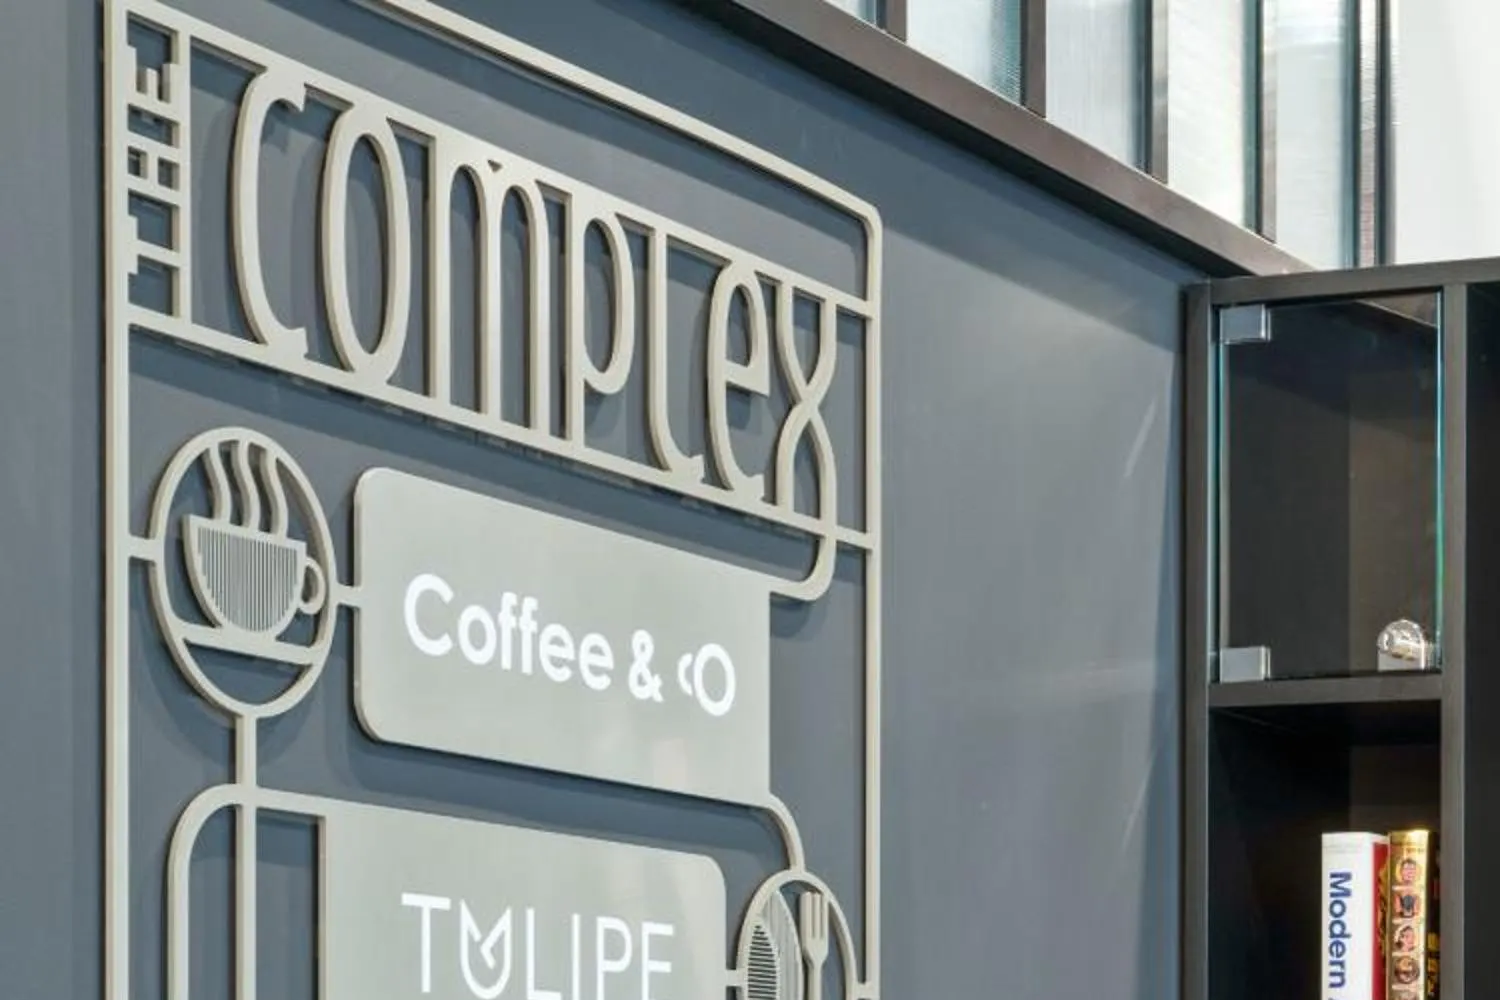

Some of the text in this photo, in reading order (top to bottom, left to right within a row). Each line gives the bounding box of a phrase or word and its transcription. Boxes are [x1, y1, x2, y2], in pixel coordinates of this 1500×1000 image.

[403, 573, 613, 690] Coffee
[627, 629, 664, 702] &
[1328, 870, 1353, 989] Modern
